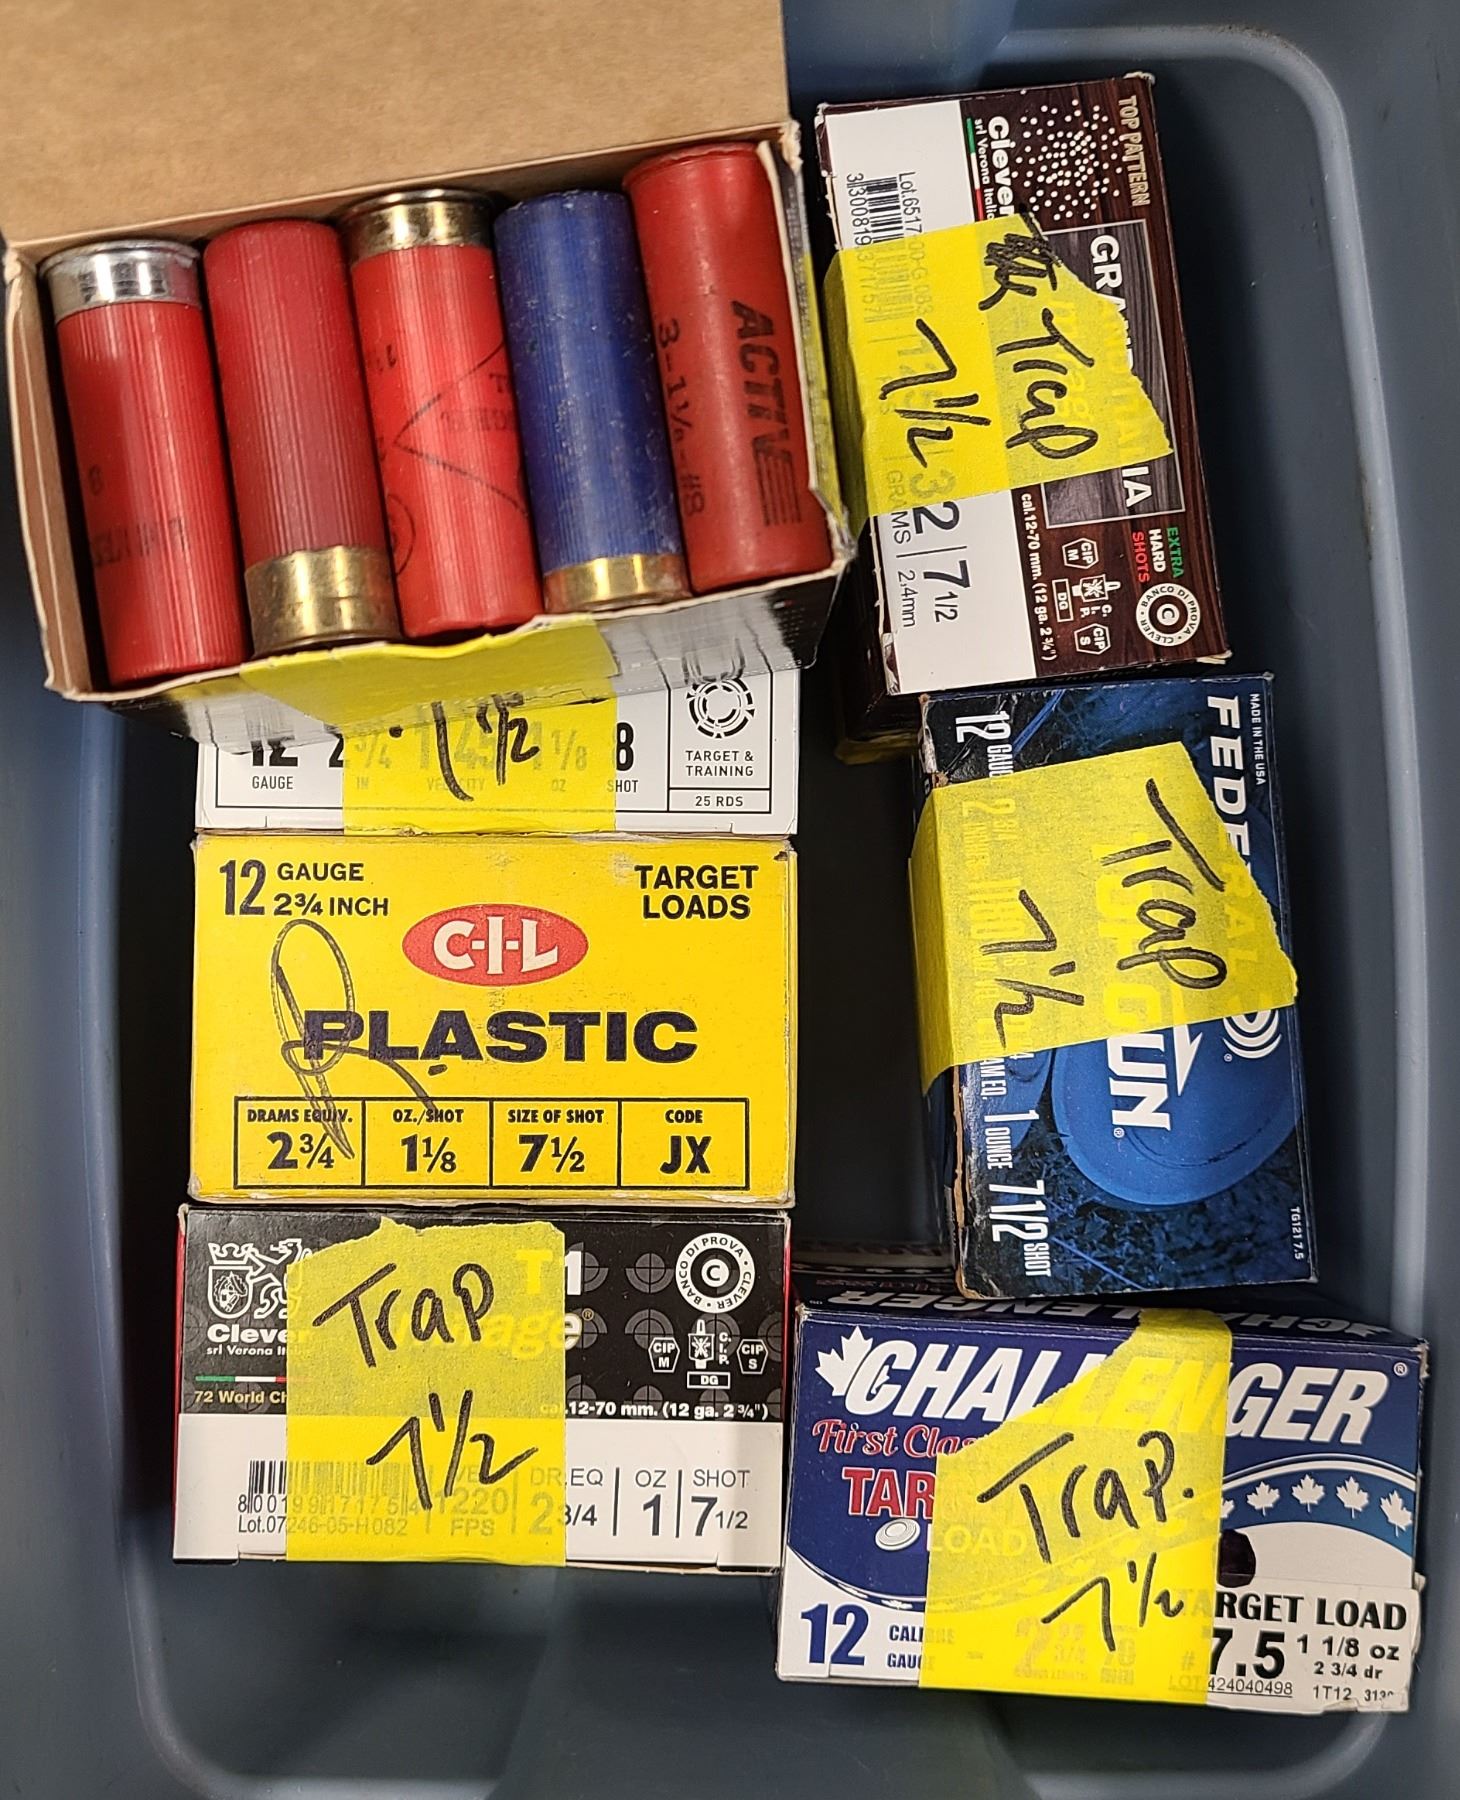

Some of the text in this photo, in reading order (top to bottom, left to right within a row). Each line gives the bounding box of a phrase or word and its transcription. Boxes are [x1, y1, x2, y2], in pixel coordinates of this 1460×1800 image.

[974, 119, 987, 135] srl
[977, 137, 991, 185] Verona
[1118, 95, 1150, 207] TOP PATTERN
[1067, 549, 1080, 561] M
[1080, 542, 1095, 565] CIP
[1132, 531, 1151, 584] SHOTS
[1148, 528, 1167, 573] HARD
[1167, 526, 1185, 579] EXTRA
[1029, 552, 1043, 581] mm.
[1032, 583, 1048, 604] (12
[1057, 592, 1069, 611] DG
[1034, 606, 1049, 626] ga.
[1141, 585, 1199, 636] BANCO DI PROVA
[1161, 607, 1175, 620] C
[1079, 636, 1091, 646] S
[1092, 627, 1106, 650] CIP
[1139, 618, 1175, 645] CLEVER
[954, 710, 1011, 744] 12
[1249, 693, 1266, 786] MADE IN THE USA
[685, 749, 755, 762] TARGET &
[685, 765, 754, 777] TRAINING
[251, 776, 294, 790] GAUGE
[695, 796, 744, 808] 25 RDS
[219, 859, 365, 916] 12 GAUGE
[634, 865, 759, 890] TARGET
[328, 897, 389, 917] INCH
[643, 894, 751, 919] LOADS
[433, 915, 559, 975] C-I-L
[303, 1009, 699, 1063] PLASTIC
[980, 1079, 1008, 1101] EQ.
[247, 1109, 353, 1123] DRAMS EQUIV.
[392, 1108, 465, 1125] OZ./SHOT
[507, 1109, 605, 1123] SIZE OF SHOT
[665, 1109, 703, 1124] CODE
[984, 1109, 1039, 1169] 1 OUNCE
[659, 1135, 712, 1175] JX
[1290, 1206, 1304, 1260] TG121 7.5
[1024, 1241, 1051, 1277] SHOT
[678, 1236, 745, 1307] BANCO DI PROVA
[705, 1264, 721, 1281] C
[716, 1271, 752, 1310] CLEVER
[206, 1345, 223, 1356] srl
[225, 1345, 274, 1356] Verona
[653, 1342, 676, 1354] CIP
[741, 1344, 764, 1356] CIP
[658, 1357, 670, 1368] M
[748, 1358, 758, 1370] S
[700, 1375, 719, 1386] DG
[193, 1390, 214, 1404] 72
[217, 1390, 265, 1404] World
[620, 1404, 659, 1417] mm.
[662, 1401, 690, 1418] (12
[693, 1404, 719, 1420] ga.
[812, 1418, 898, 1457] First
[635, 1469, 668, 1488] OZ
[692, 1469, 751, 1489] SHOT
[643, 1494, 662, 1537] 1
[1316, 1597, 1407, 1631] LOAD
[801, 1602, 870, 1666] 12
[1203, 1626, 1285, 1680] 7.5
[1297, 1634, 1309, 1655] 1
[1322, 1635, 1360, 1658] 1/8
[1369, 1643, 1400, 1661] oz
[1313, 1661, 1383, 1680] 2 3/4 dr
[1207, 1678, 1293, 1696] 424040498
